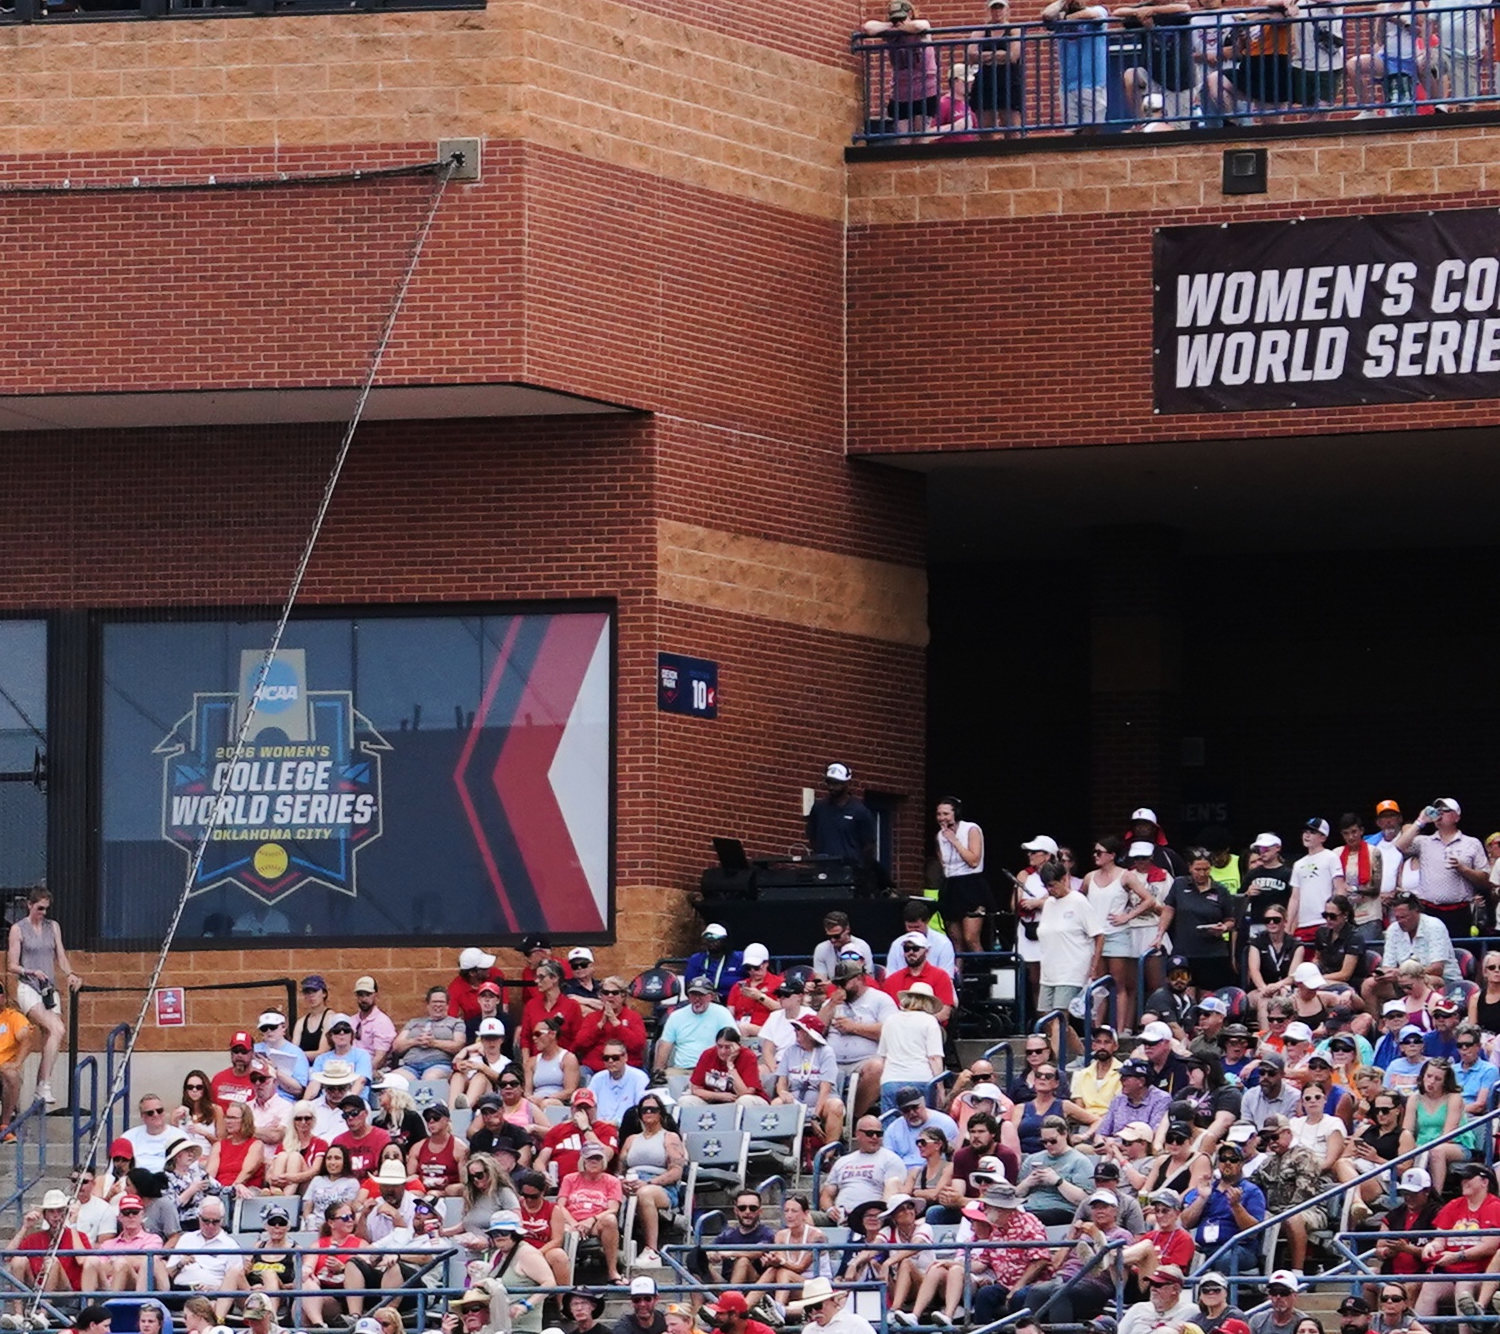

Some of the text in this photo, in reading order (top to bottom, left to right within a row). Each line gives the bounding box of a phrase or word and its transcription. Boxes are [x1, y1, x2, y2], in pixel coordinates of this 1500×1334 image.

[1175, 261, 1418, 328] WOMEN'S
[1175, 324, 1350, 389] WORLD
[692, 679, 707, 710] 10
[215, 745, 331, 759] 2026 WOMEN'S
[212, 760, 334, 792] COLLEGE
[171, 793, 375, 826] WORLD SERIES
[1180, 803, 1227, 821] EN'S
[213, 828, 333, 842] OKLAHOMA CITY
